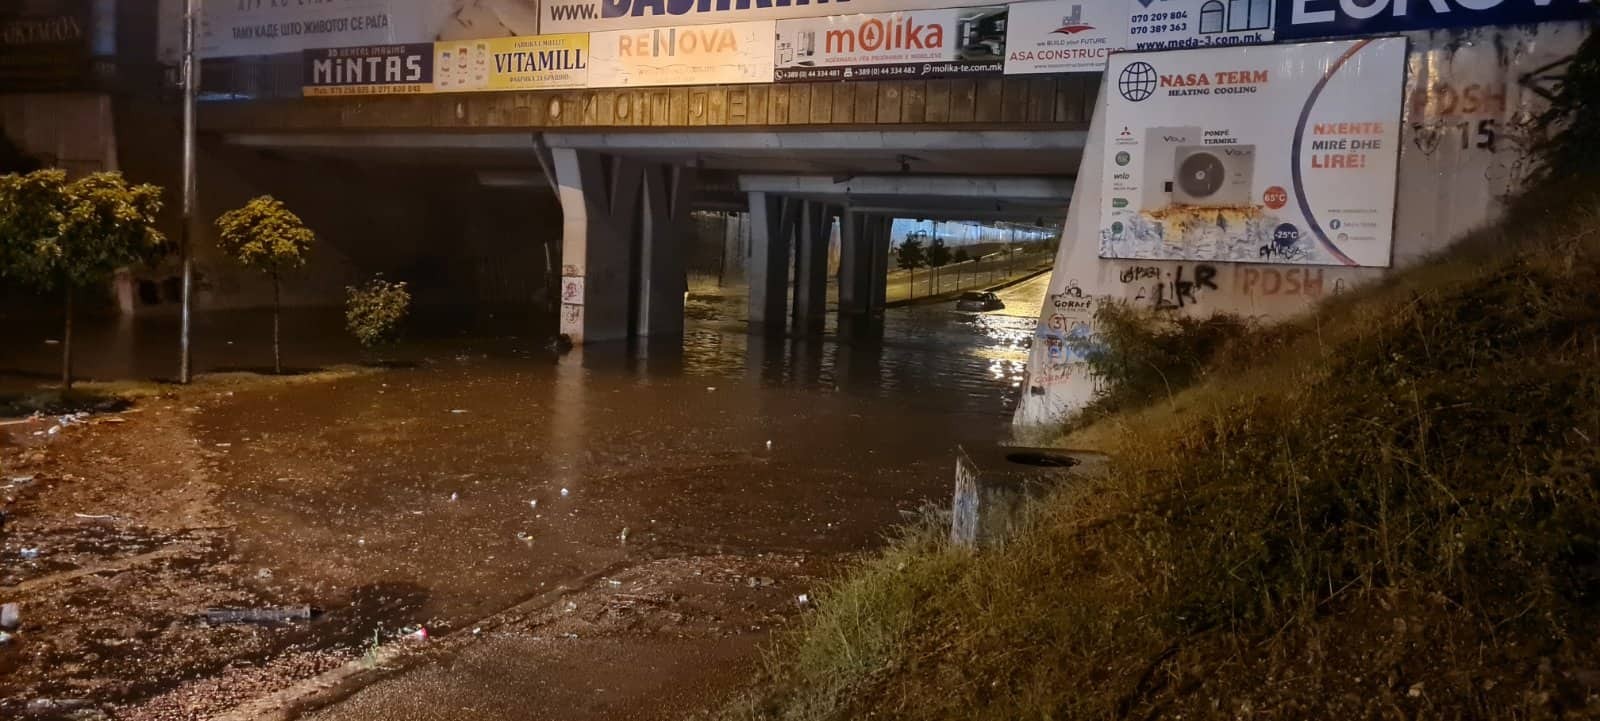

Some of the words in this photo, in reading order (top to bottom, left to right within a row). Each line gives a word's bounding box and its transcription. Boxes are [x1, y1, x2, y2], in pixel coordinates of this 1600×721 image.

[1131, 15, 1149, 23] 070
[1151, 13, 1168, 21] 209
[1170, 11, 1188, 20] 804
[254, 24, 279, 38] КАДЕ
[280, 22, 302, 36] ШТО
[303, 17, 348, 34] ЖИВОТОТ
[351, 17, 363, 30] СЕ
[1150, 25, 1168, 33] 389
[1169, 23, 1187, 31] 363
[619, 28, 737, 57] RENOVA
[1136, 32, 1263, 50] www.meda-3.com.mk
[495, 49, 586, 73] VITAMILL
[1010, 51, 1034, 61] ASA
[854, 67, 870, 76] +389
[881, 67, 889, 75] 44
[903, 66, 916, 74] 482
[932, 63, 1003, 73] molika-te.com.mk
[1160, 74, 1210, 87] NASA
[1215, 70, 1269, 85] TERM
[1168, 87, 1210, 97] HEATING
[1214, 86, 1257, 95] COOLING
[1312, 138, 1347, 150] MIRË
[1350, 139, 1381, 150] DHE
